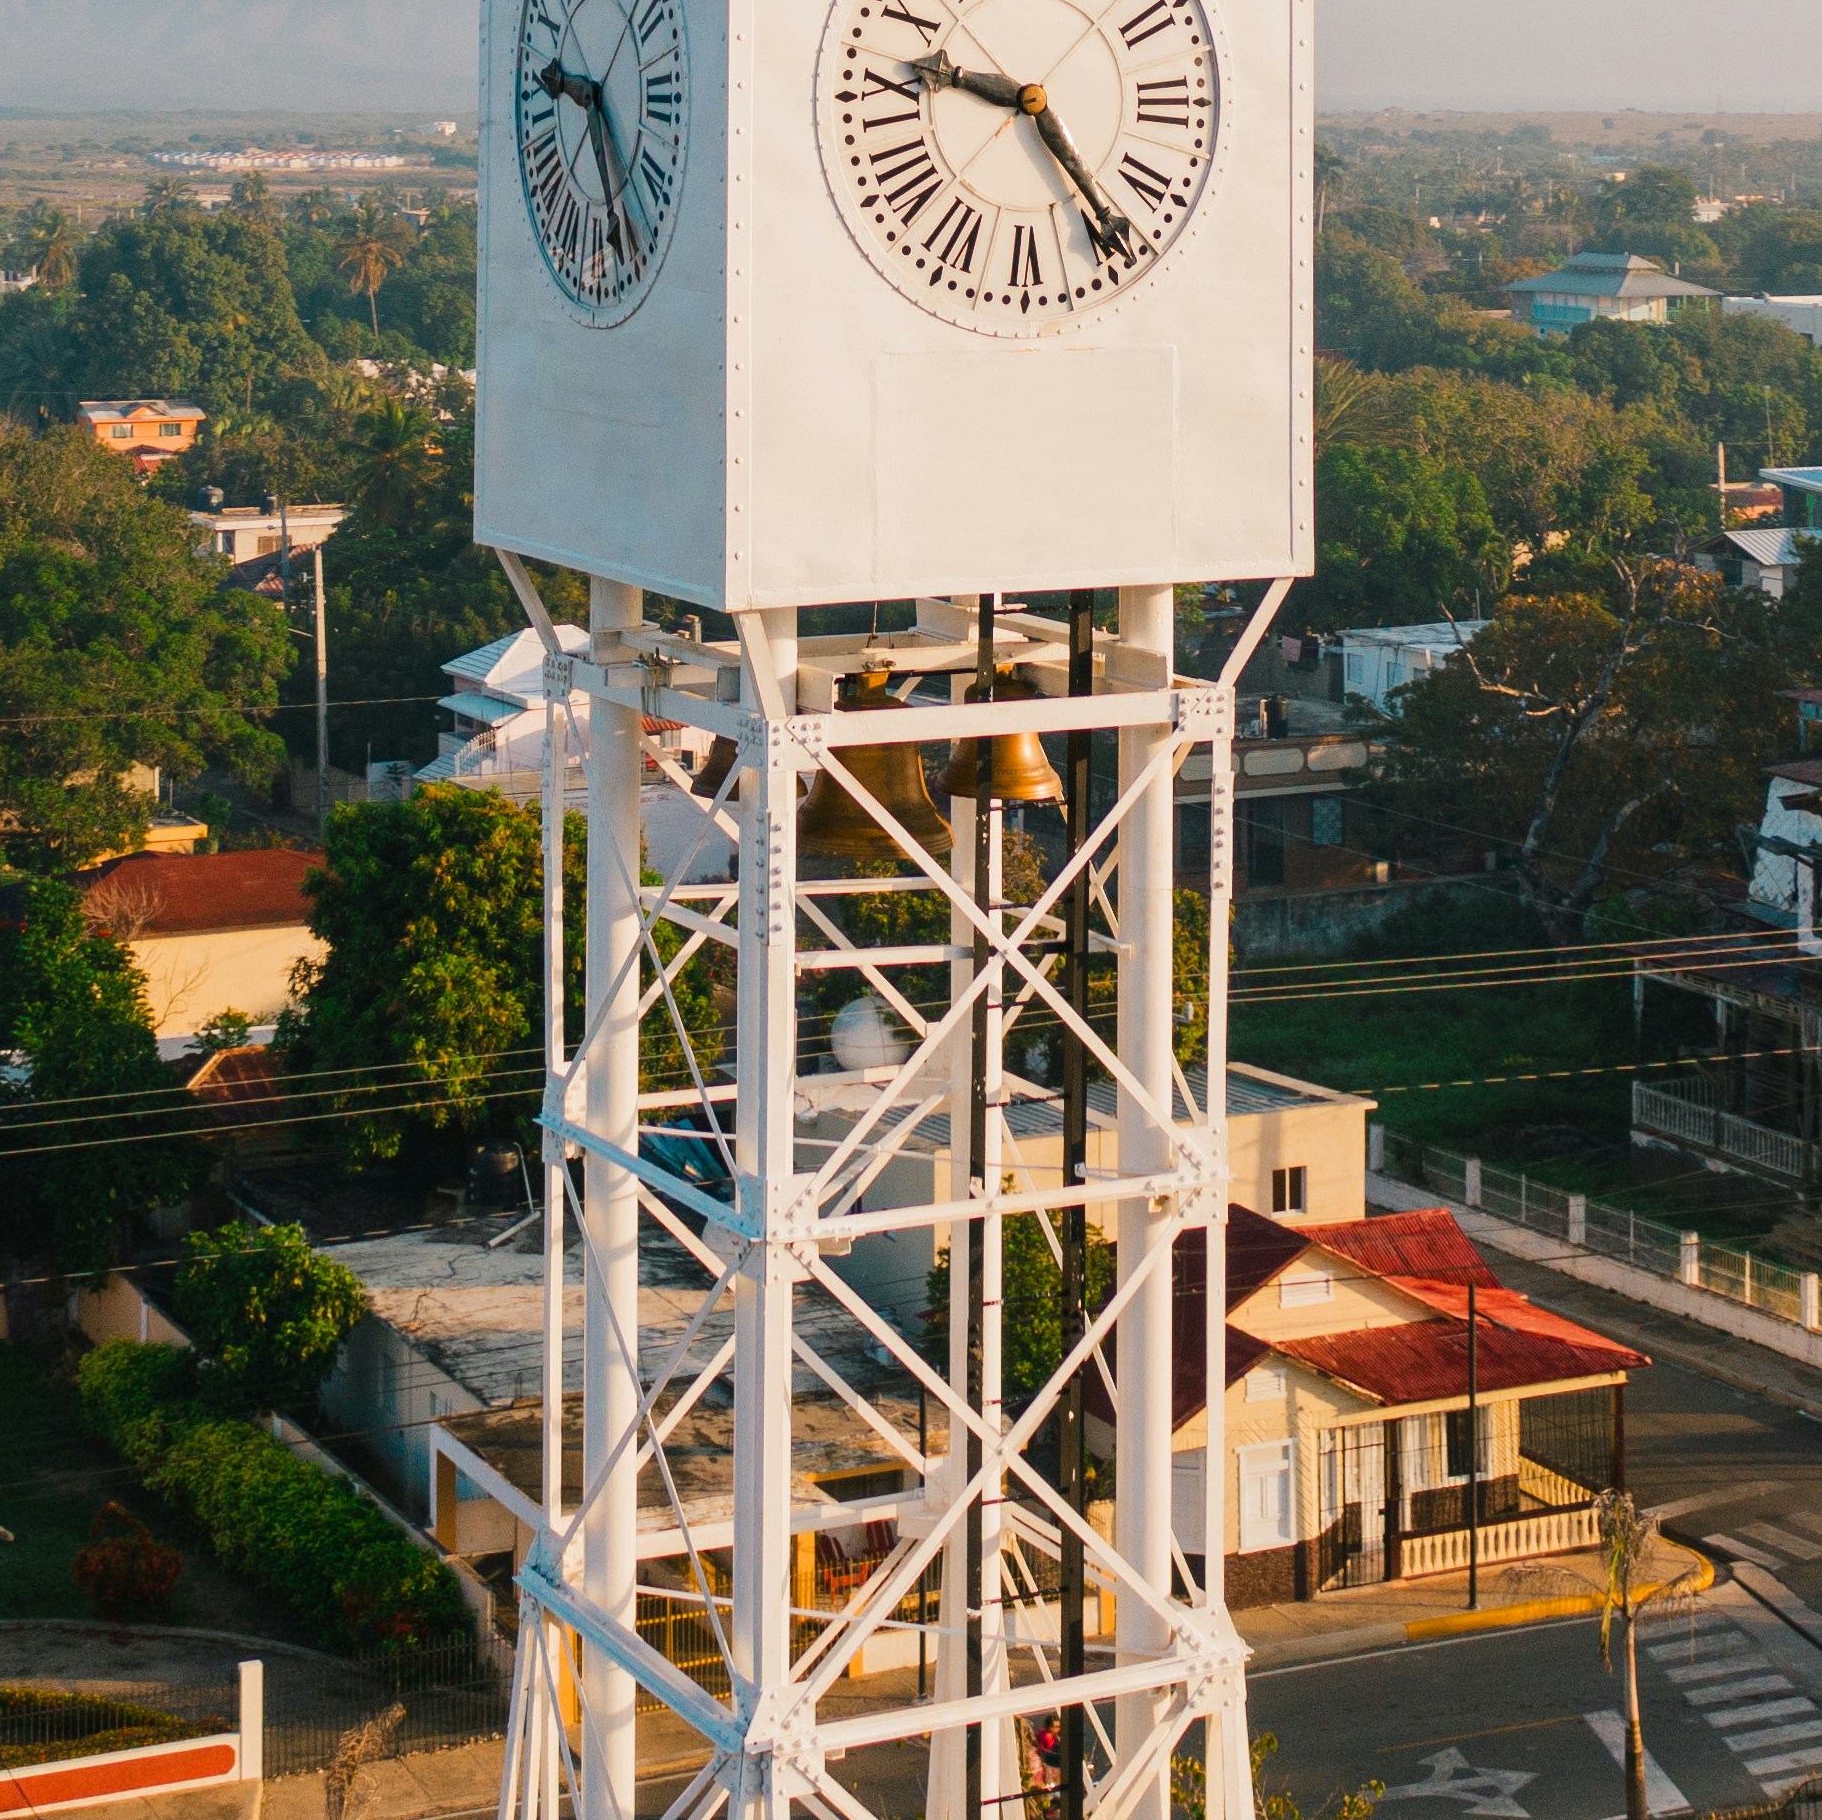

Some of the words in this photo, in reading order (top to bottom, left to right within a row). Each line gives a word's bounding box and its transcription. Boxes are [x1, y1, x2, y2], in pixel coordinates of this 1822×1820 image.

[646, 70, 673, 128] III
[861, 68, 921, 133] IX
[1136, 75, 1189, 129] III
[532, 130, 564, 216] VIII
[640, 146, 666, 208] IV
[869, 136, 944, 227] VIII
[1118, 152, 1172, 213] IV
[554, 188, 580, 264] VII
[590, 217, 608, 280] VI
[921, 196, 983, 274] VII
[1007, 225, 1044, 287] VI
[1081, 208, 1116, 267] V
